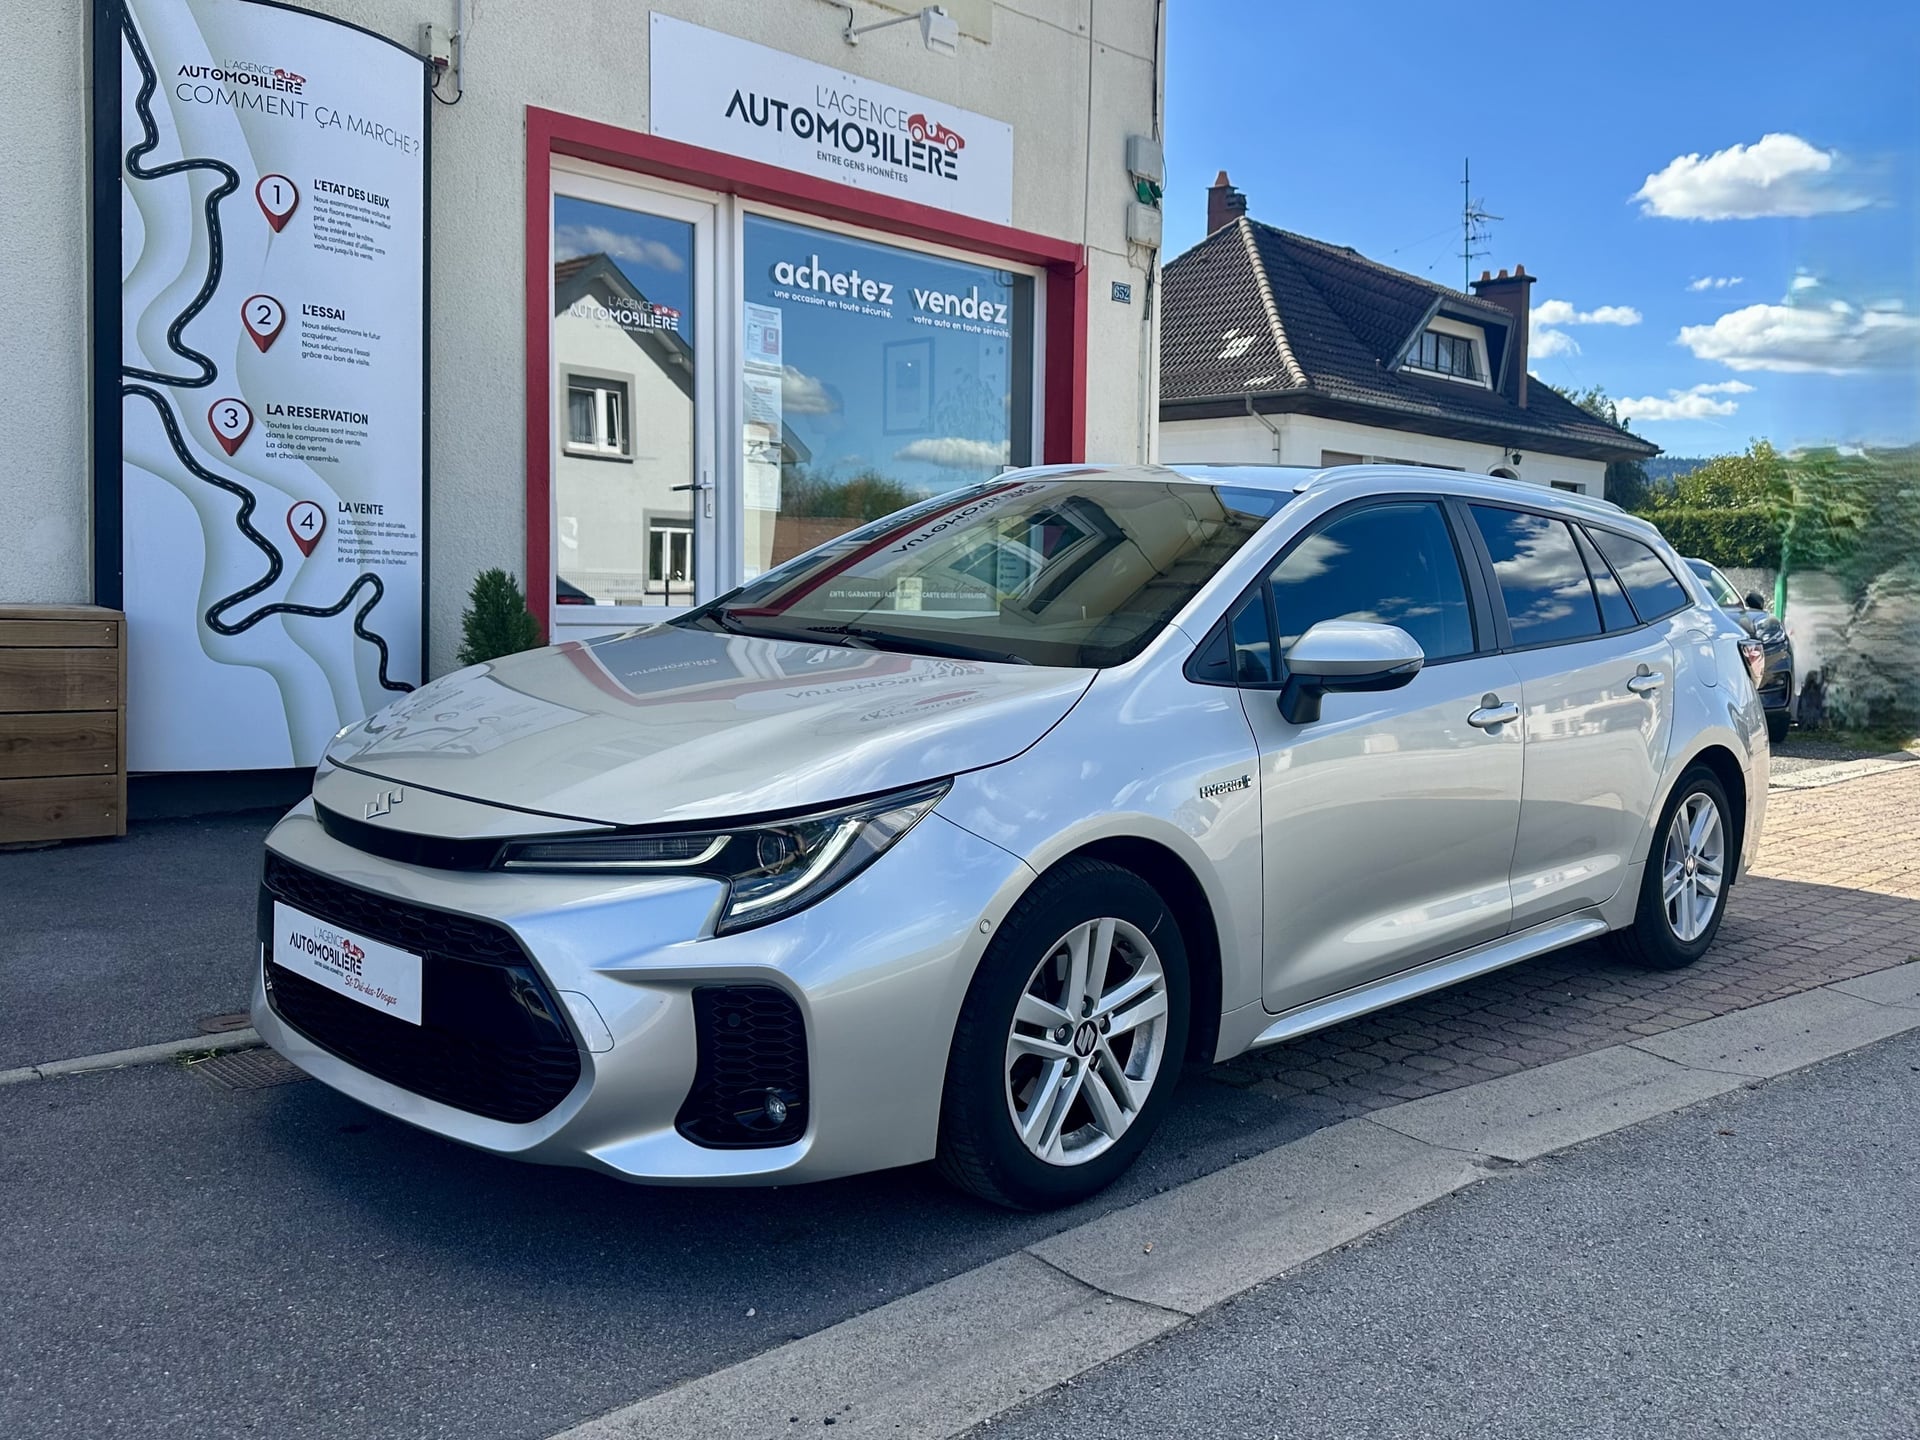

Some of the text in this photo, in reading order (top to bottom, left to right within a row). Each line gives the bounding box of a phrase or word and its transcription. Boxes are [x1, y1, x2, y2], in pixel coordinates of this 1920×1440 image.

[224, 59, 274, 75] L'AGENCE
[176, 83, 309, 120] COMMENT
[315, 106, 342, 129] ÇA
[817, 84, 908, 132] L'AGENCE
[817, 151, 908, 183] ENTRE GENS HONNÊTES
[273, 184, 280, 204] 1
[313, 195, 328, 204] Nous
[314, 179, 389, 208] L'ETAT DES LIEUX
[313, 205, 327, 213] nous
[329, 207, 344, 216] fixons
[313, 214, 324, 222] prix
[313, 223, 328, 231] Votre
[313, 232, 327, 241] Vous
[775, 254, 893, 305] achetez
[1115, 285, 1129, 300] 652
[303, 304, 345, 320] L'ESSAI
[608, 296, 653, 312] L'AGENCE
[775, 290, 893, 318] une occasion en toute sécurité.
[914, 286, 1007, 324] vendez
[257, 305, 271, 325] 2
[301, 320, 319, 329] Nous
[913, 316, 932, 324] votre
[934, 319, 950, 327] auto
[963, 324, 981, 333] toute
[301, 340, 319, 348] Nous
[301, 350, 321, 360] grâce
[333, 354, 345, 362] bon
[224, 408, 238, 428] 3
[266, 404, 368, 425] LA RESERVATION
[266, 421, 290, 429] Toutes
[304, 424, 328, 432] clauses
[277, 441, 294, 449] date
[295, 434, 333, 444] compromis
[278, 451, 304, 460] choisie
[338, 502, 383, 515] LA VENTE
[301, 512, 314, 530] 4
[1200, 779, 1243, 798] HYBRID
[314, 925, 343, 947] L'AGENCE
